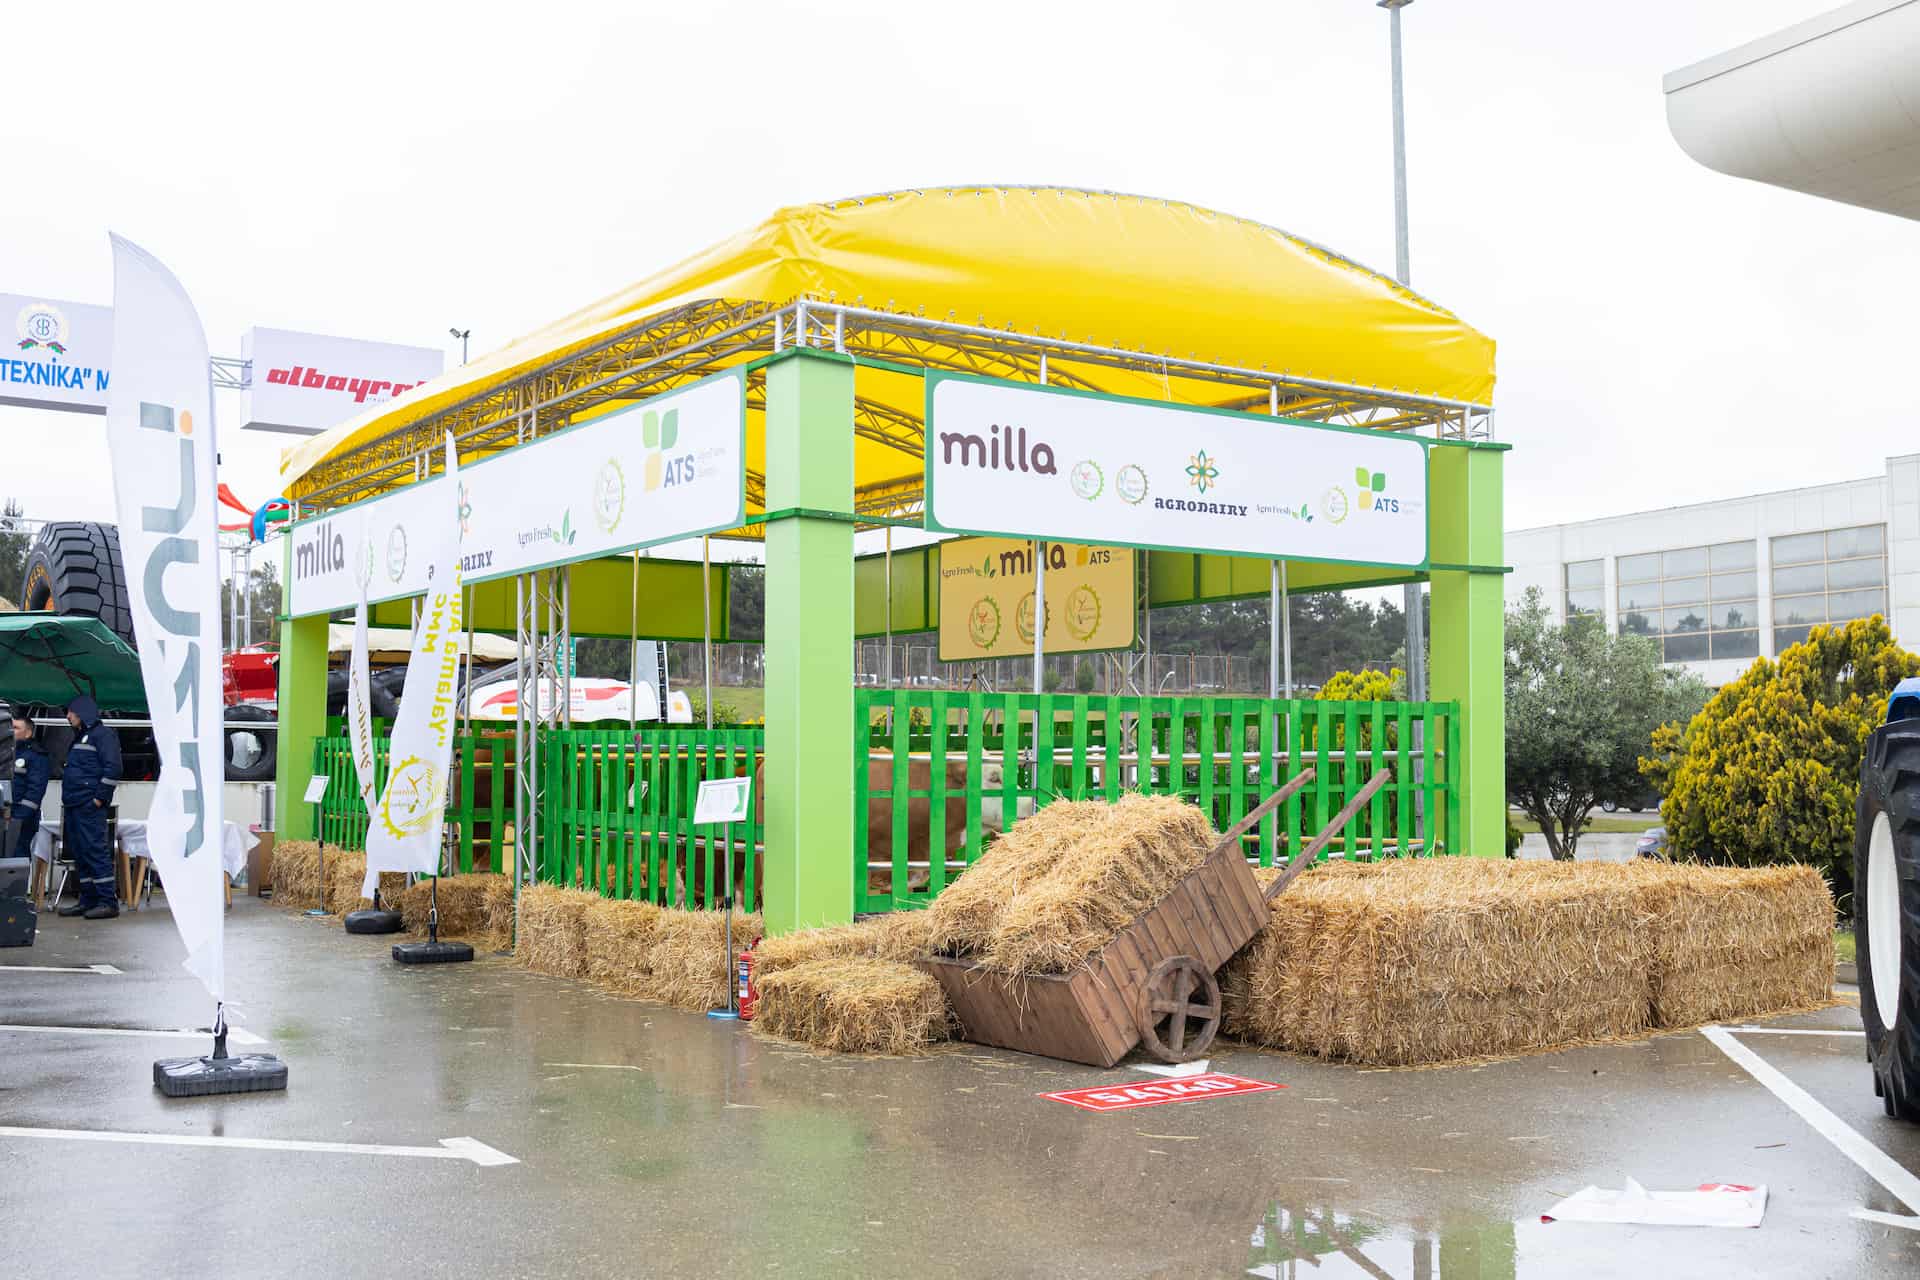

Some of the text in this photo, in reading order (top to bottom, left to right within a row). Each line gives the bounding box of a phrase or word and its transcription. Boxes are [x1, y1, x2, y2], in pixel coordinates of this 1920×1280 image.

[939, 424, 1057, 476] milla
[663, 453, 695, 489] ATS
[1374, 497, 1399, 513] ATS
[296, 519, 345, 581] milla
[1089, 549, 1111, 565] ATS
